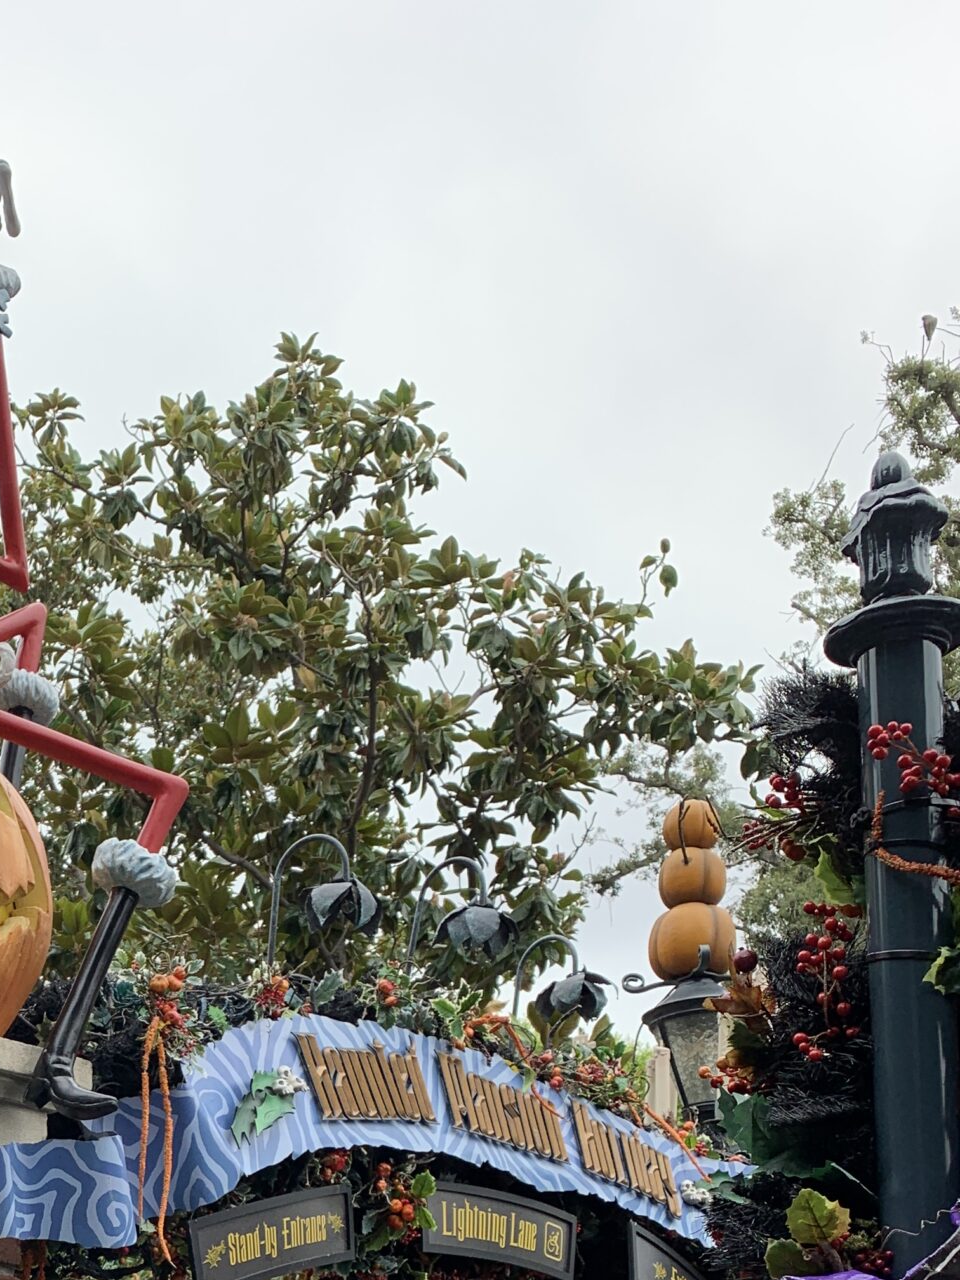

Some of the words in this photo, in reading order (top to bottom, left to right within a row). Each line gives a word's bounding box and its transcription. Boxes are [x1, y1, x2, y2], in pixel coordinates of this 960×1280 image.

[293, 1032, 438, 1124] Haunted
[436, 1049, 570, 1163] Mansion
[228, 1221, 278, 1266] Stand-by
[282, 1214, 327, 1250] Entrance
[441, 1198, 507, 1249] Lightning
[510, 1212, 538, 1252] Lane
